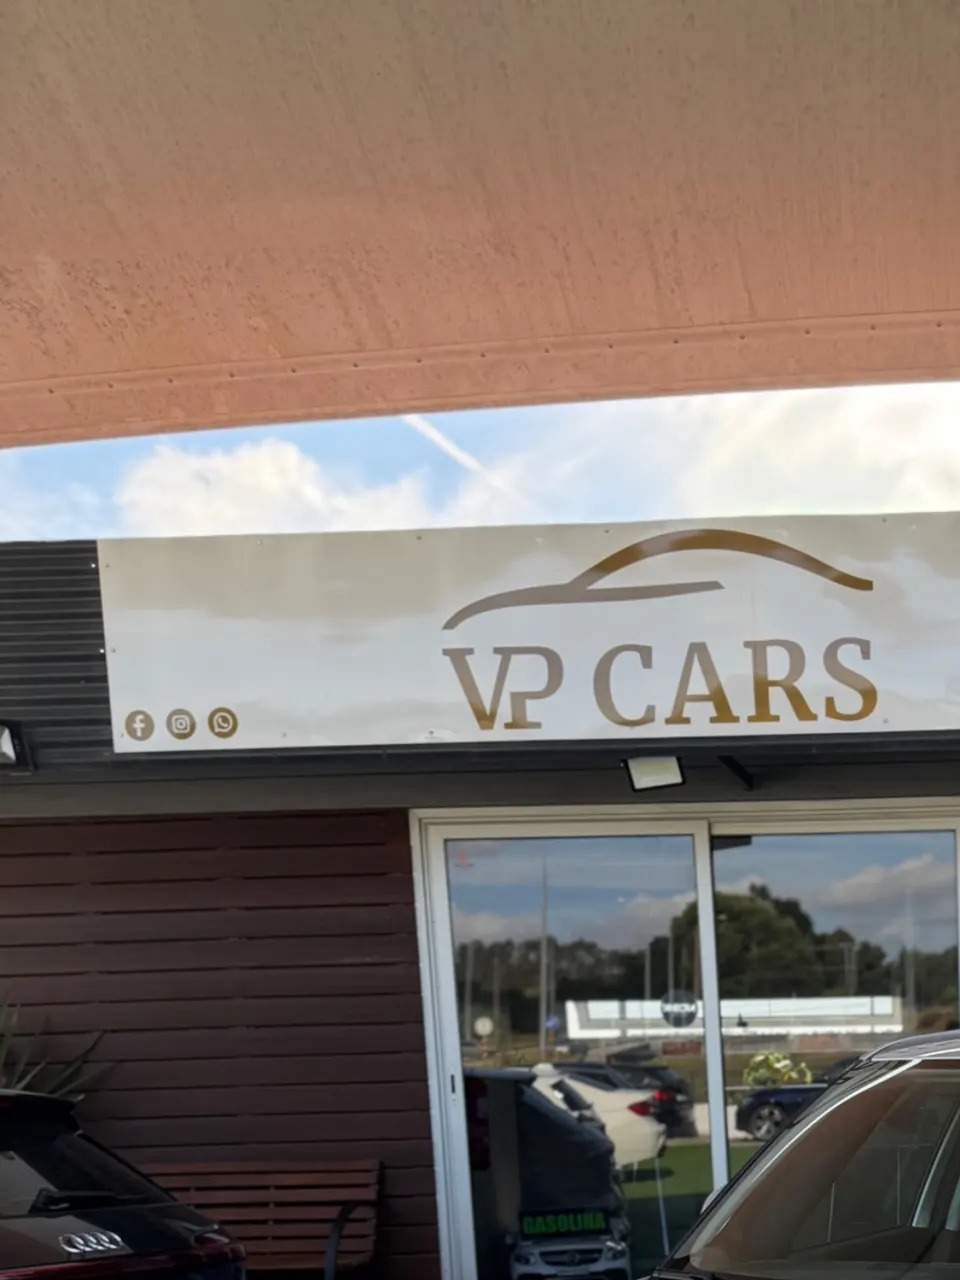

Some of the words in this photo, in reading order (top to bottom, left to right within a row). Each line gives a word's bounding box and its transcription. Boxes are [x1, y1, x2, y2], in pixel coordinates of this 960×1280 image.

[442, 646, 564, 730] VP
[593, 637, 879, 727] CARS
[523, 1212, 607, 1235] GASOLINA
